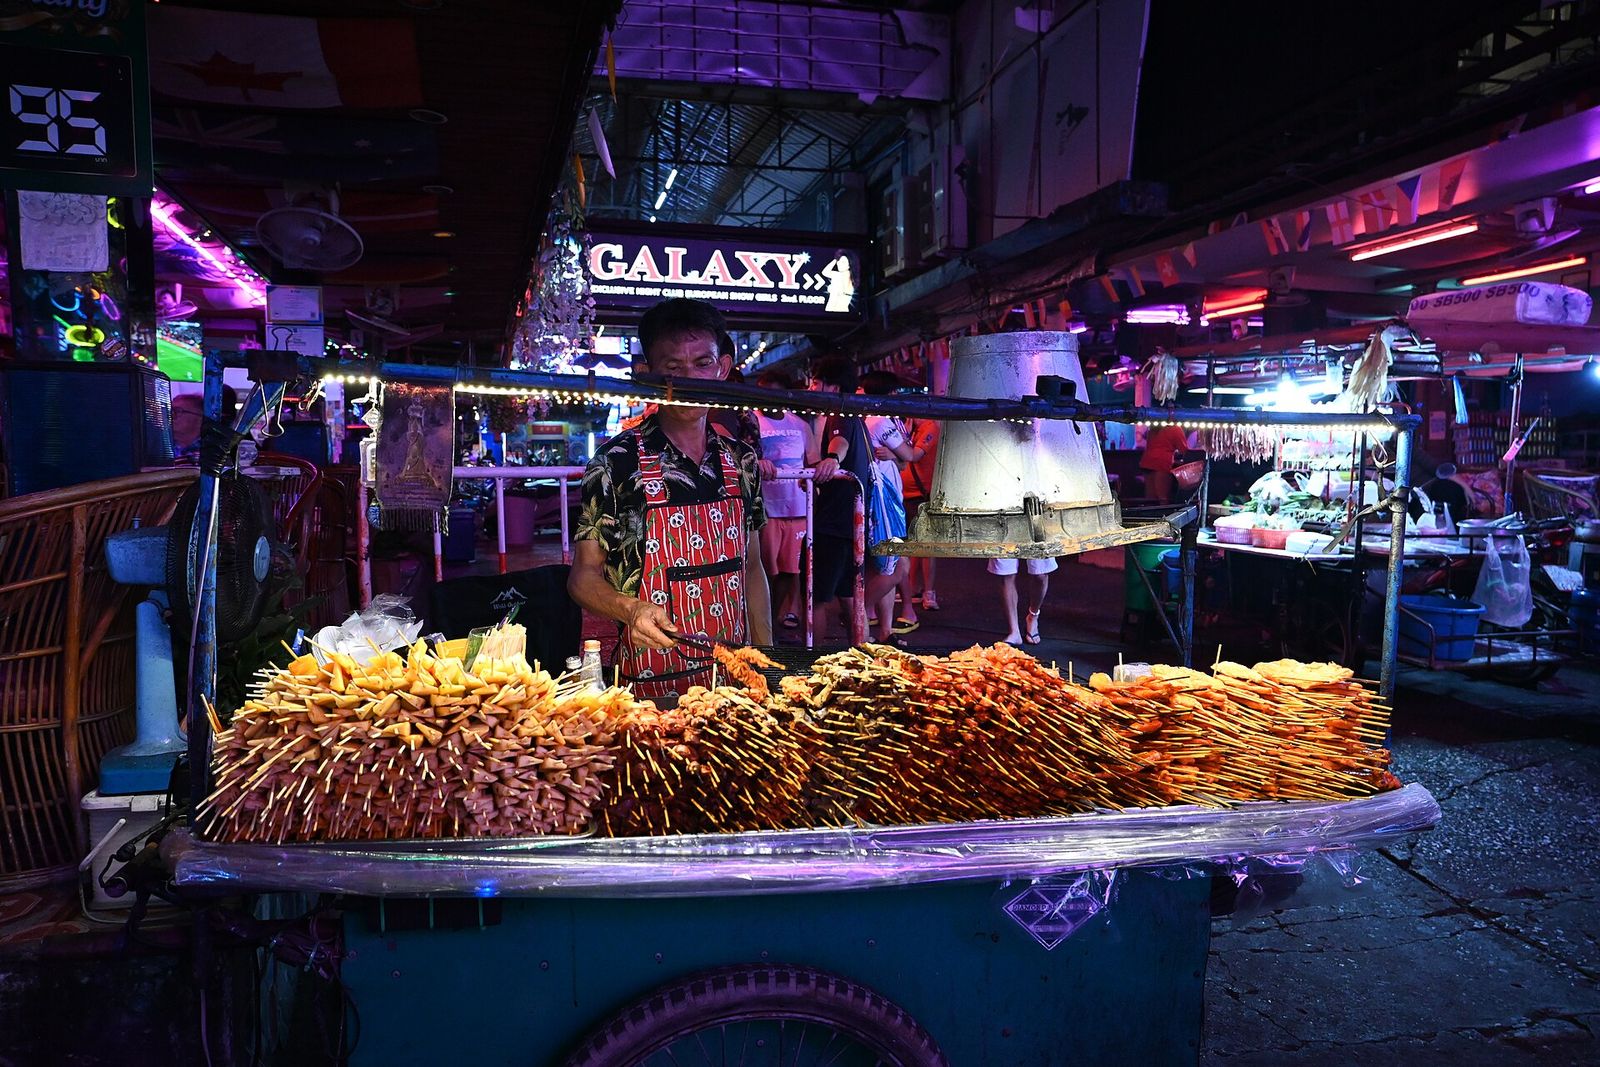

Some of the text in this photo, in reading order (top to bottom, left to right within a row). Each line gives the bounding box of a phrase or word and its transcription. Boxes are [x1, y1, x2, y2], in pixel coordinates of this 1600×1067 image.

[9, 84, 107, 156] 95
[589, 243, 807, 290] GALAXY
[591, 285, 635, 295] EXCLUSIVE
[636, 287, 661, 297] NIGHT
[662, 288, 684, 298] CLUB
[685, 290, 729, 299] EUROPEAN
[729, 292, 754, 301] SHOW
[755, 293, 778, 303] GIRLS
[799, 295, 825, 304] FLOOR
[1433, 290, 1481, 308] SB500
[1485, 282, 1541, 299] SB500
